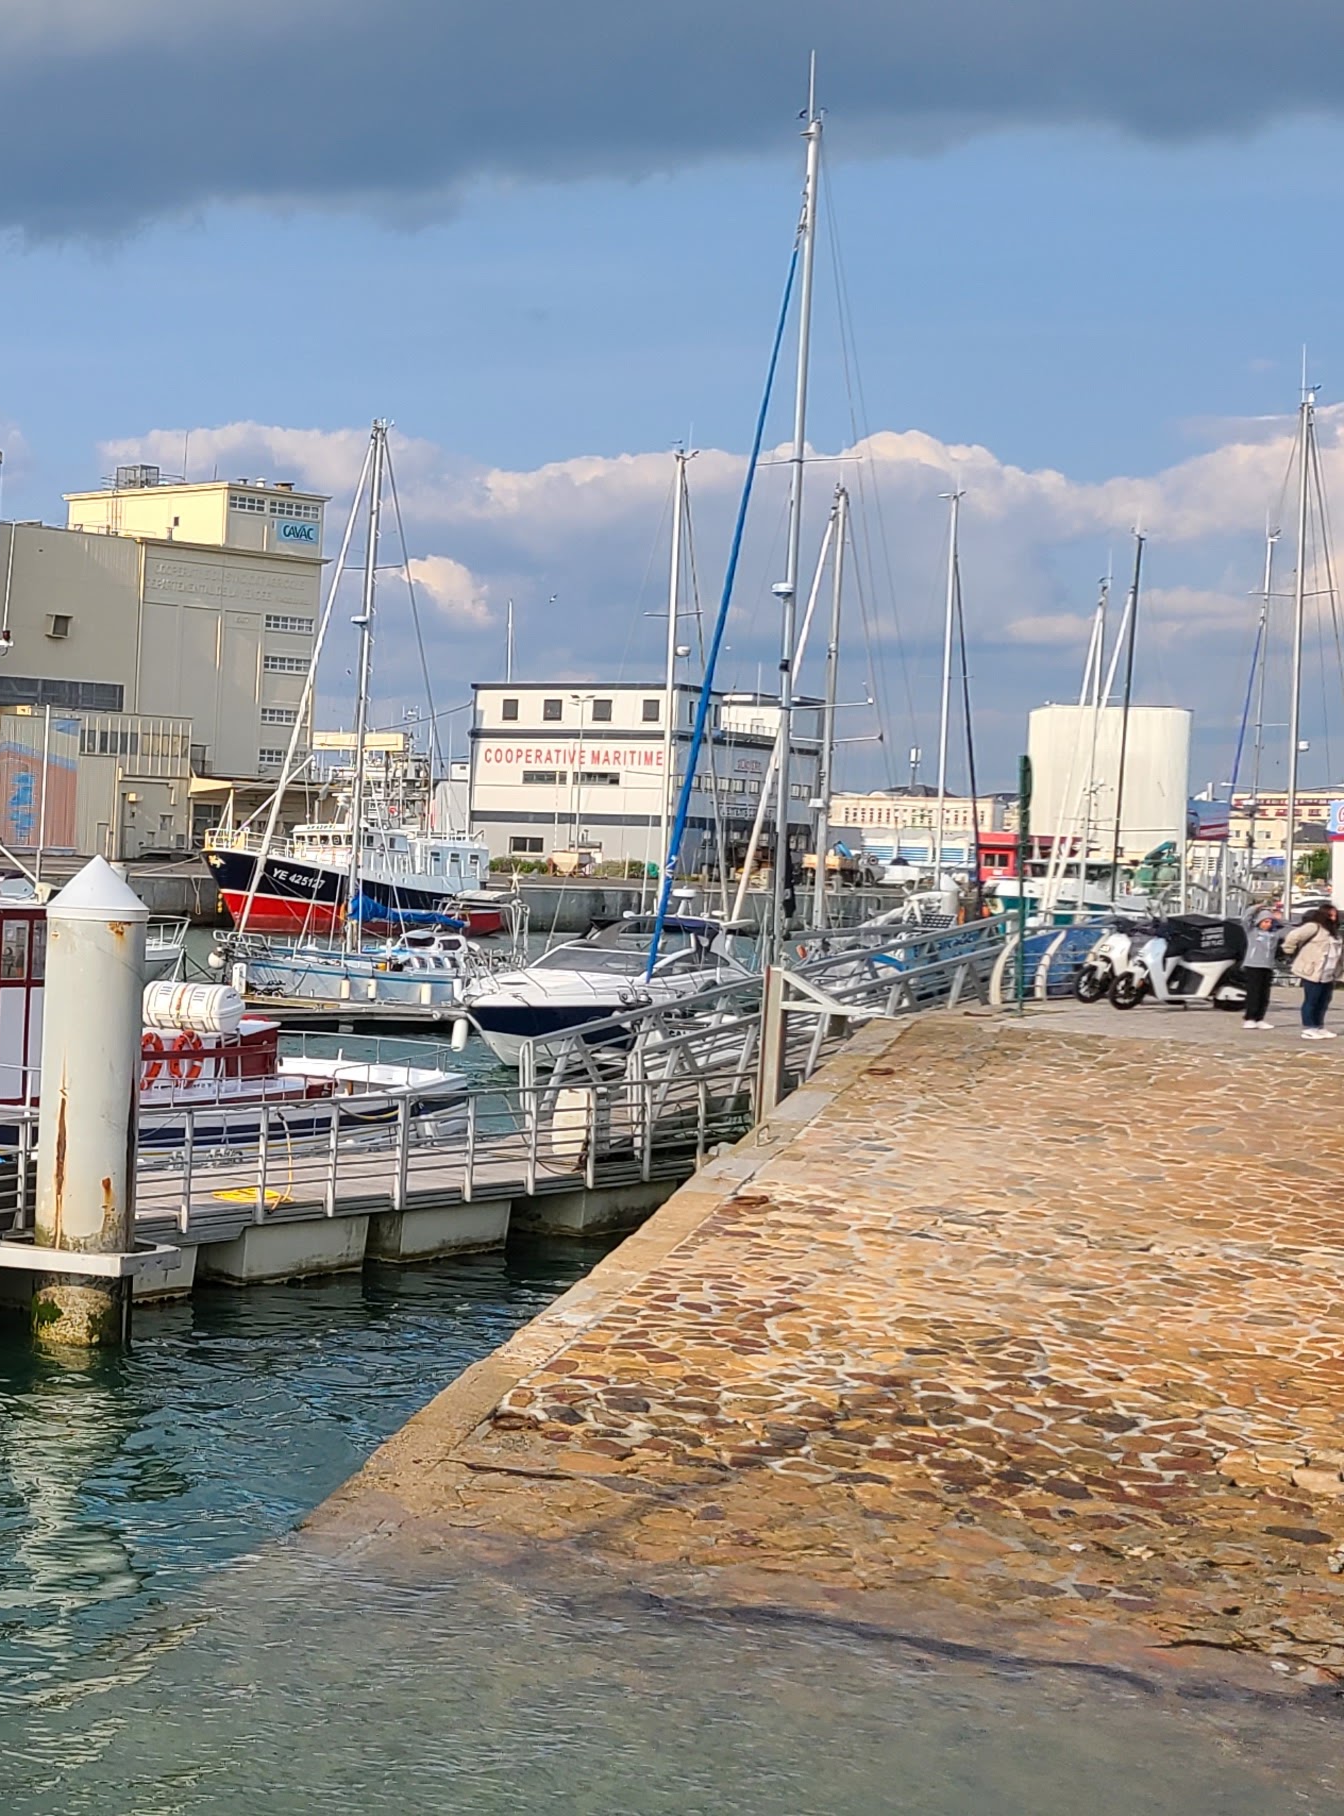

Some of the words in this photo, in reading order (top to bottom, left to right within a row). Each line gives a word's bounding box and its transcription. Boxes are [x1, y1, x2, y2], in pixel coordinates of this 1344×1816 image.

[283, 525, 314, 540] CAVAC
[484, 748, 586, 765] COOPERATIVE
[590, 749, 664, 766] MARITIME
[272, 868, 288, 881] YE
